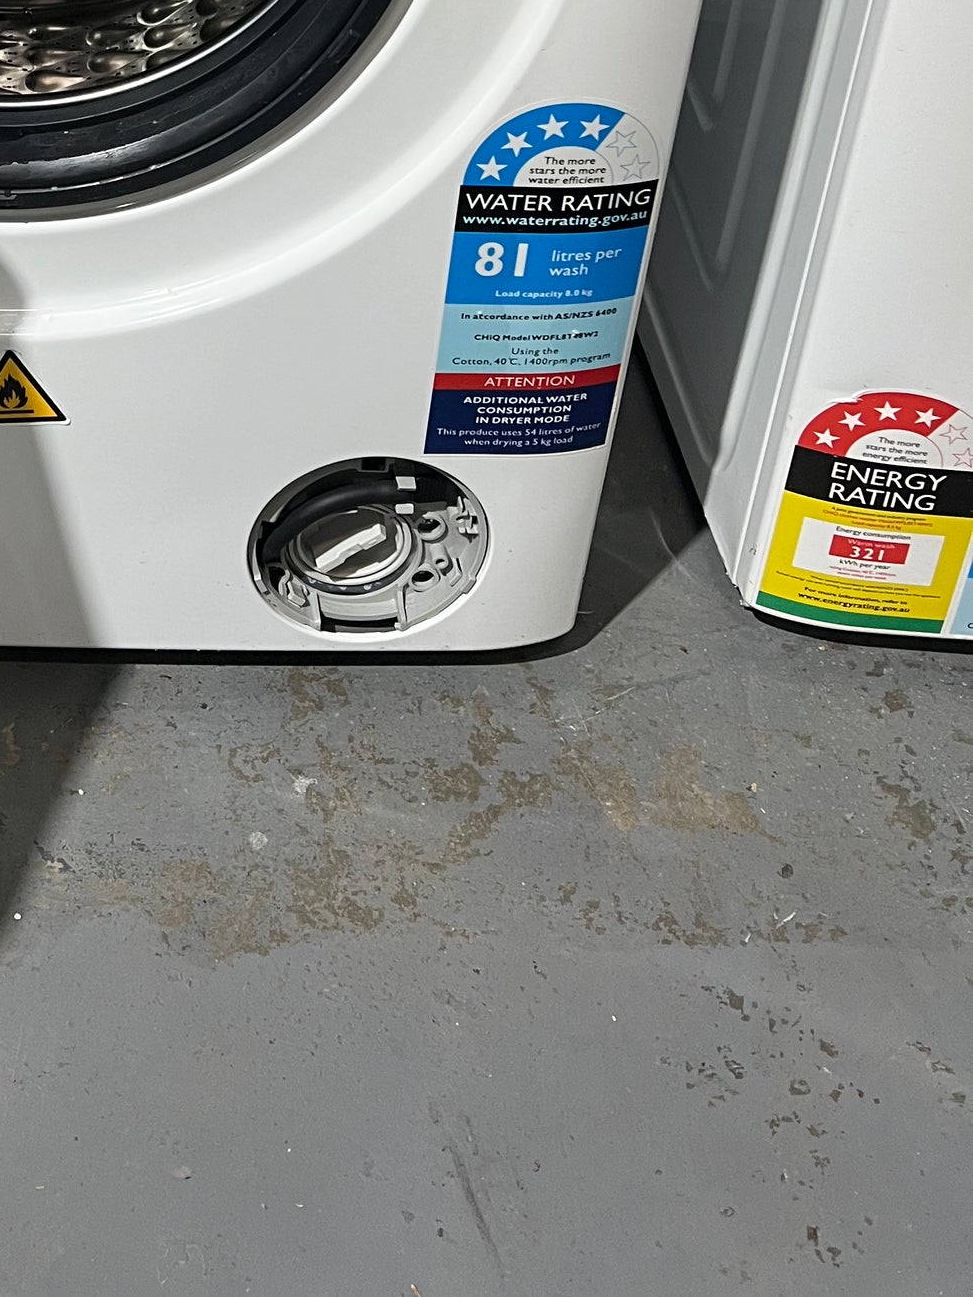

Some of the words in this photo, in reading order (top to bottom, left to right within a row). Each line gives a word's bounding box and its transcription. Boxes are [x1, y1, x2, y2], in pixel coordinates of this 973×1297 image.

[544, 156, 565, 166] The
[567, 158, 596, 166] more
[529, 167, 555, 175] stars
[558, 166, 576, 175] the
[578, 166, 606, 175] more
[562, 176, 605, 184] efficient
[465, 193, 553, 212] WATER
[560, 188, 652, 212] RATING
[462, 210, 648, 228] www.waterrating.gov.au
[551, 250, 592, 262] litres
[594, 248, 623, 263] per
[549, 264, 588, 276] wash
[495, 290, 520, 298] Load
[522, 290, 563, 299] capacity
[565, 289, 580, 297] 8.0
[581, 289, 593, 298] kg
[532, 313, 553, 321] with
[554, 310, 594, 320] AS/NZS
[595, 307, 617, 317] 6400
[474, 334, 501, 342] CHiQ
[502, 334, 531, 342] Model
[511, 347, 540, 357] Using
[542, 347, 559, 356] the
[570, 353, 611, 365] program
[484, 375, 575, 388] ATTENTION
[463, 396, 544, 405] ADDITIONAL
[545, 392, 588, 404] WATER
[477, 404, 572, 415] CONSUMPTION
[475, 416, 490, 424] IN
[492, 416, 531, 425] DRYER
[534, 414, 570, 424] MODE
[436, 428, 457, 436] This
[459, 429, 499, 438] produce
[501, 429, 522, 437] uses
[524, 428, 536, 436] 54
[538, 428, 563, 436] litres
[564, 426, 576, 435] of
[575, 422, 602, 433] water
[464, 438, 491, 446] when
[492, 438, 523, 448] drying
[533, 438, 539, 446] 5
[541, 438, 552, 447] kg
[553, 435, 574, 445] load
[878, 436, 895, 445] The
[897, 440, 920, 448] more
[865, 444, 887, 452] stars
[862, 452, 892, 461] energy
[894, 455, 927, 464] efficient
[831, 461, 948, 491] ENERGY
[828, 482, 936, 511] RATING
[836, 526, 861, 536] Energy
[863, 531, 911, 541] consumption
[847, 538, 873, 547] Warm
[849, 545, 884, 561] 321
[839, 559, 858, 567] kWh
[798, 592, 911, 613] www.energyrating.gov.au
